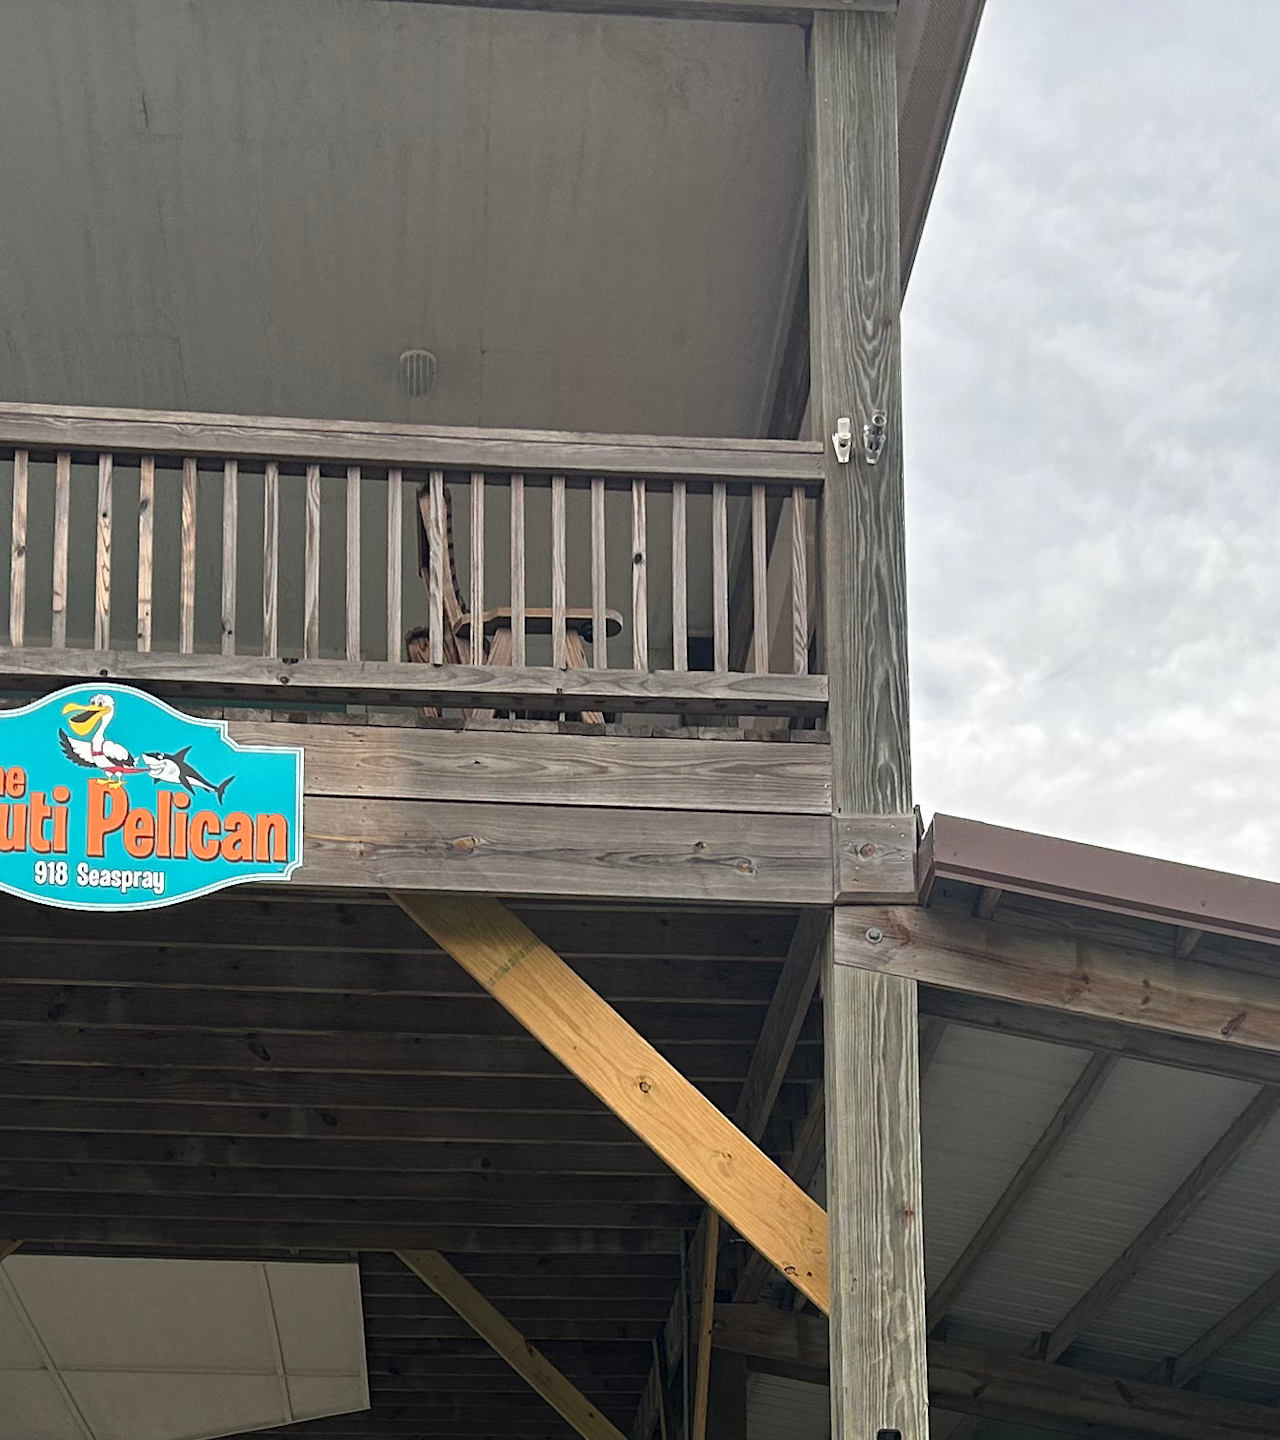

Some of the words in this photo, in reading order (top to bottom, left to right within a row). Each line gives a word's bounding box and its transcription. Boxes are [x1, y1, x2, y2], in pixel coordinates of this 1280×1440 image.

[86, 778, 287, 863] Pelican
[34, 861, 68, 885] 918
[77, 862, 165, 894] Seaspray
